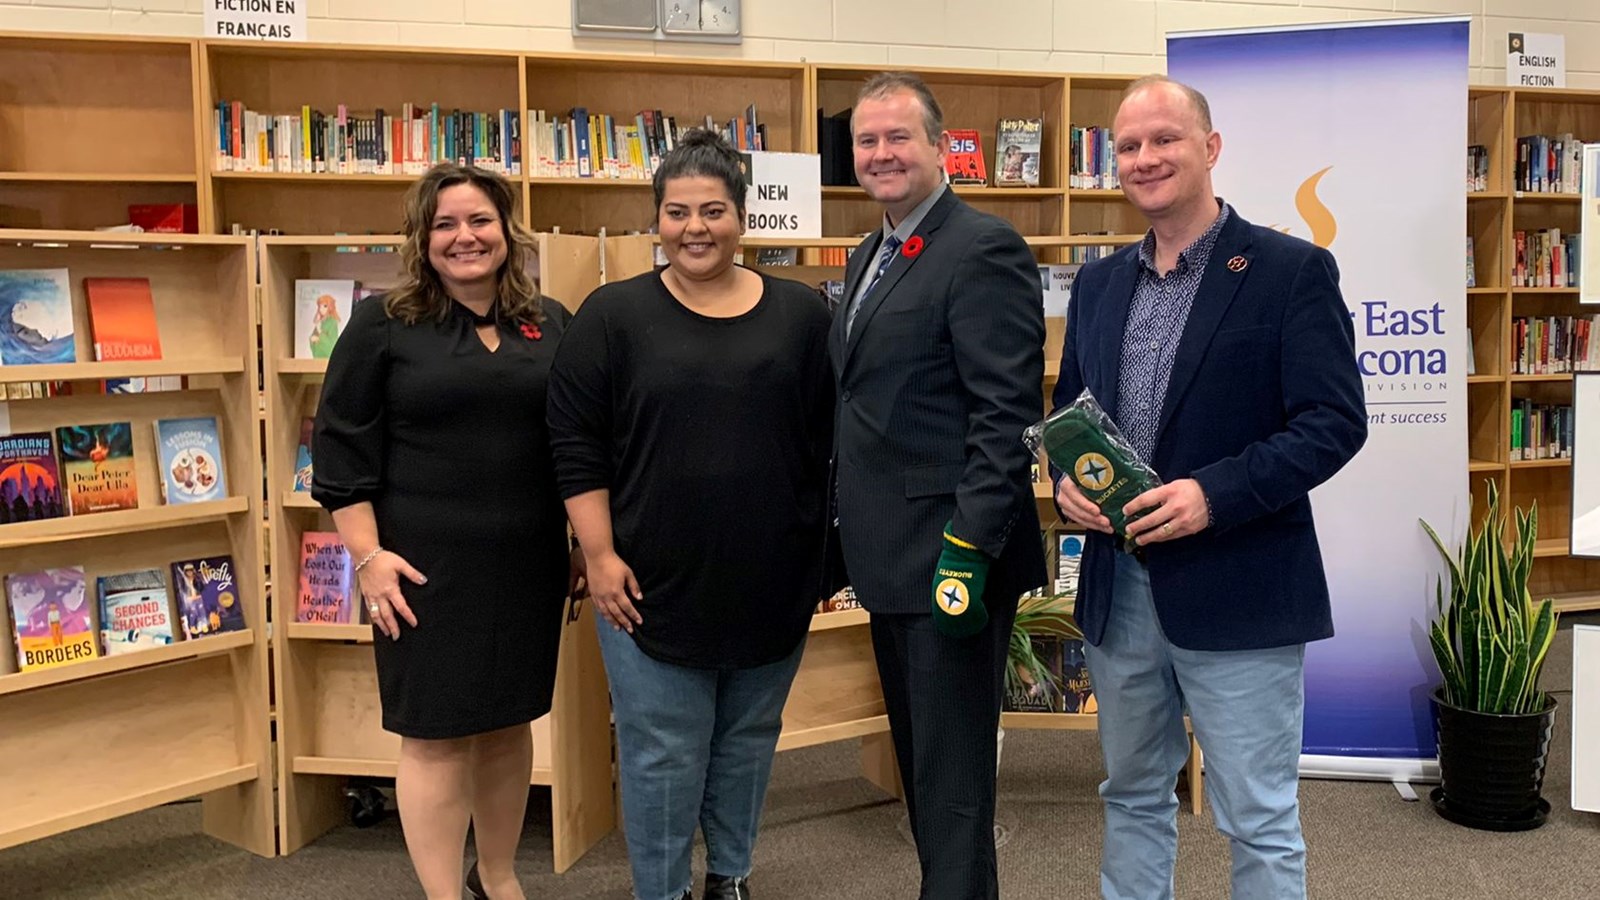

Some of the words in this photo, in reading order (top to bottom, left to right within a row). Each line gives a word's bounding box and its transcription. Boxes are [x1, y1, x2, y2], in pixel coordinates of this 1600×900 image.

[215, 0, 271, 12] FICTION
[276, 0, 295, 14] EN
[217, 21, 291, 40] FRANÇAIS
[1519, 55, 1556, 68] ENGLISH
[1521, 74, 1554, 86] FICTION
[758, 184, 788, 201] NEW
[748, 213, 798, 230] BOOKS
[1361, 301, 1445, 336] East
[103, 342, 154, 358] BUDDHISM
[1358, 349, 1446, 376] cona
[1367, 382, 1447, 392] IVISION
[1367, 412, 1386, 424] nt
[1390, 412, 1447, 424] success
[73, 472, 99, 483] Dear
[102, 470, 130, 480] Peter
[77, 483, 103, 493] Dear
[335, 544, 346, 555] W
[303, 594, 343, 607] Heather
[115, 601, 159, 619] SECOND
[112, 613, 166, 632] CHANCES
[25, 640, 92, 666] BORDERS
